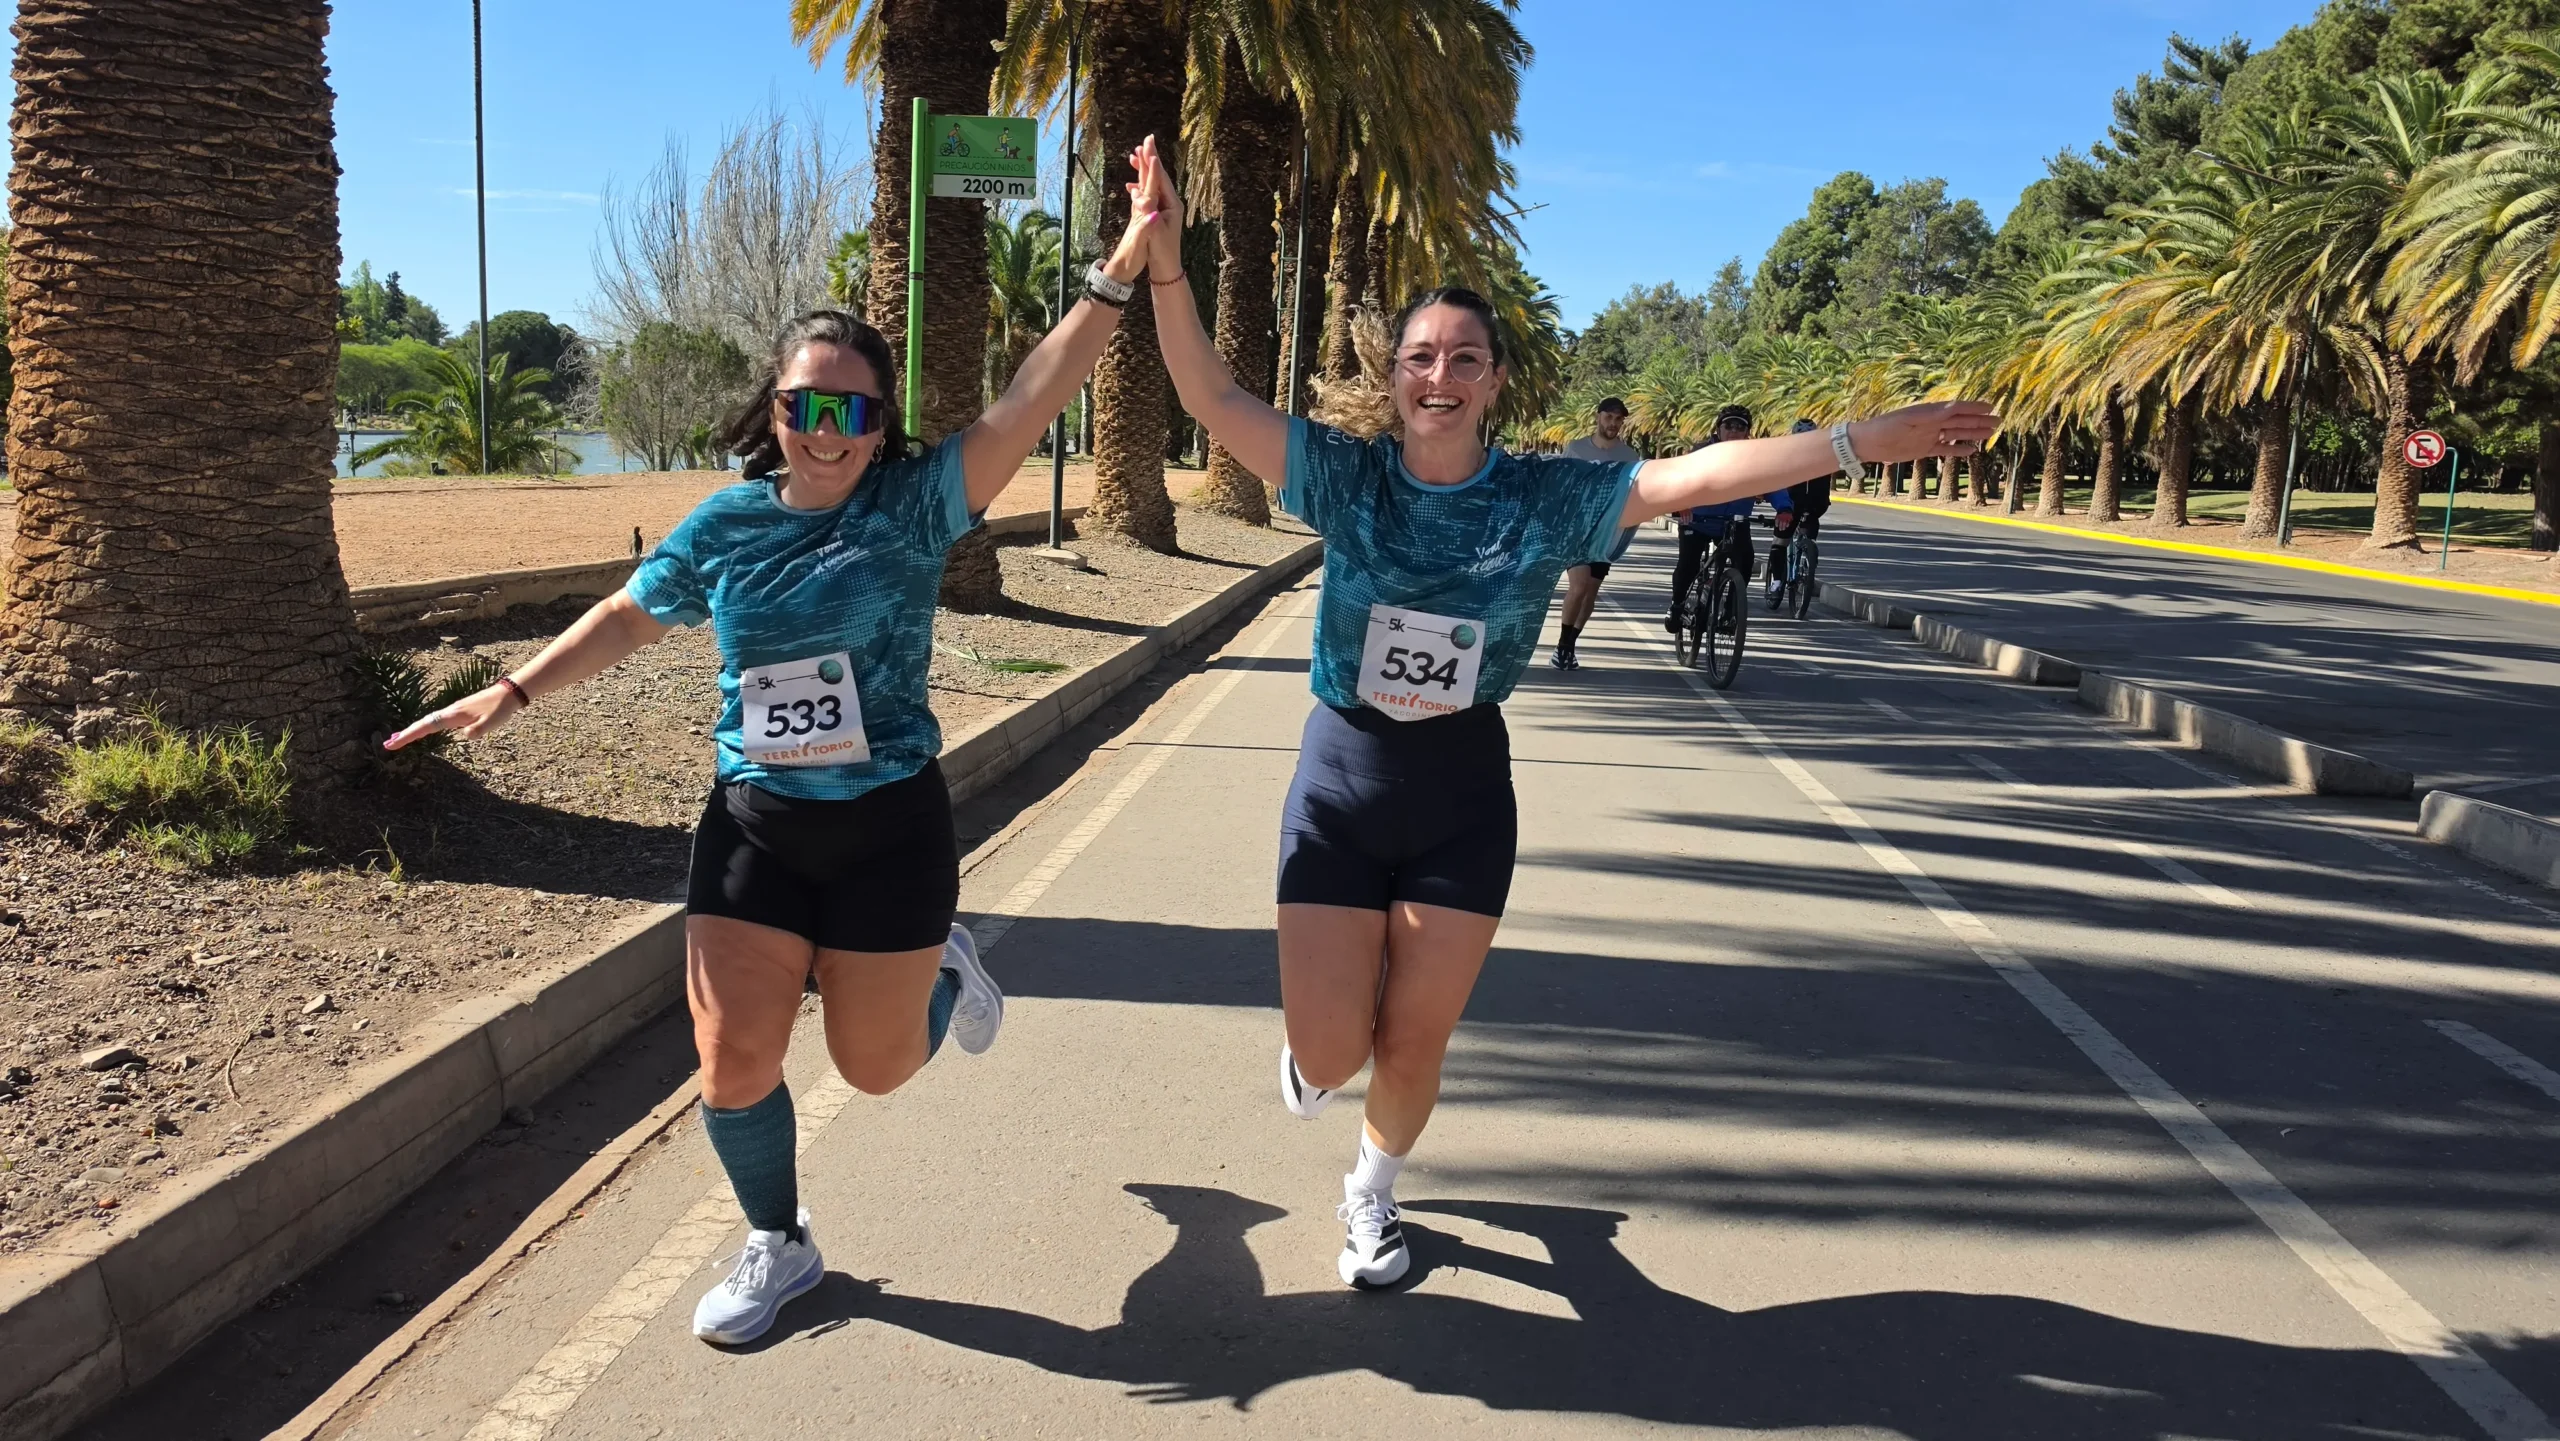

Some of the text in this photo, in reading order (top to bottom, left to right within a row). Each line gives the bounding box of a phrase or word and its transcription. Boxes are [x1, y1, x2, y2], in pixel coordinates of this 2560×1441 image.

[940, 160, 1026, 172] PRECAUCIÓN NIÑOS
[962, 178, 1025, 195] 2200 m
[1388, 618, 1406, 633] 5k
[1380, 646, 1460, 692] 534
[758, 676, 777, 690] 5k
[764, 695, 842, 738] 533
